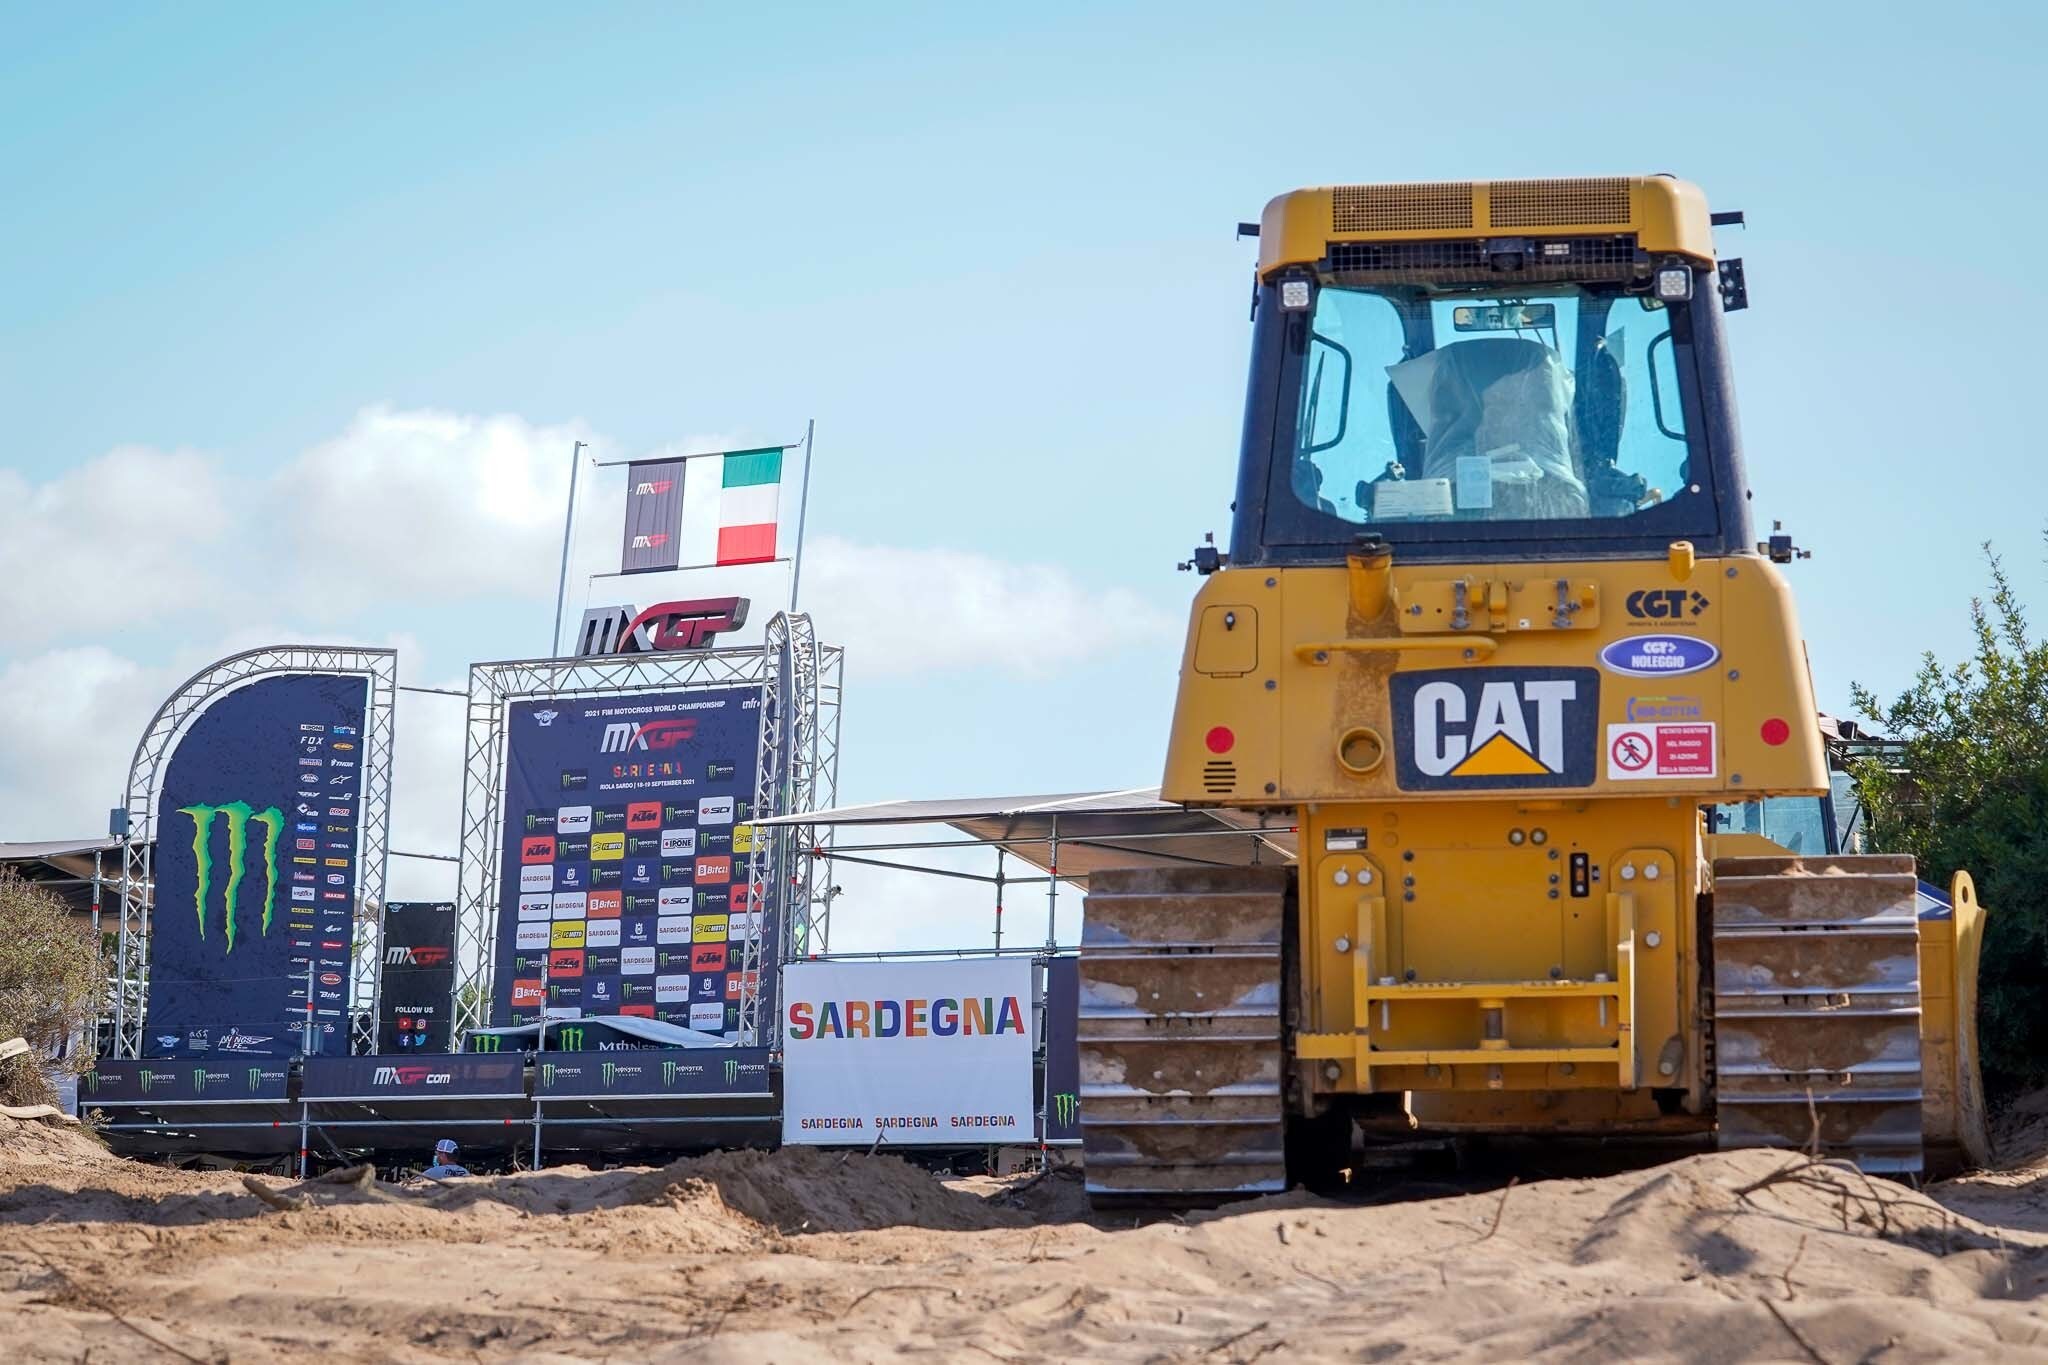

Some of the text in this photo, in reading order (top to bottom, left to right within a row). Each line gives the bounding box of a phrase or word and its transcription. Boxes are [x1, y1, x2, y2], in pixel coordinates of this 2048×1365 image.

[636, 480, 672, 495] MXGP
[632, 534, 669, 548] MXGP
[1626, 590, 1688, 618] CGT
[575, 597, 751, 656] MXGP
[1643, 641, 1668, 654] CGT
[1632, 655, 1685, 668] NOLEGGIO
[602, 708, 613, 716] FIM
[614, 706, 653, 715] MOTOCROSS
[653, 704, 676, 712] WORLD
[678, 700, 726, 711] CHAMPIONSHIP
[1413, 680, 1577, 777] CAT
[300, 736, 324, 745] FOX
[600, 718, 698, 755] MXGP
[651, 779, 682, 787] SEPTEMBER
[526, 843, 551, 857] KTM
[385, 946, 449, 966] MXGP
[395, 1006, 434, 1014] FOLLOW US
[789, 997, 1025, 1040] SARDEGNA
[372, 1066, 433, 1086] MXGP
[554, 1067, 582, 1075] MONSTER
[614, 1066, 642, 1074] MONSTER
[801, 1115, 1016, 1130] SARDEGNA SARDEGNA SARDEGNA
